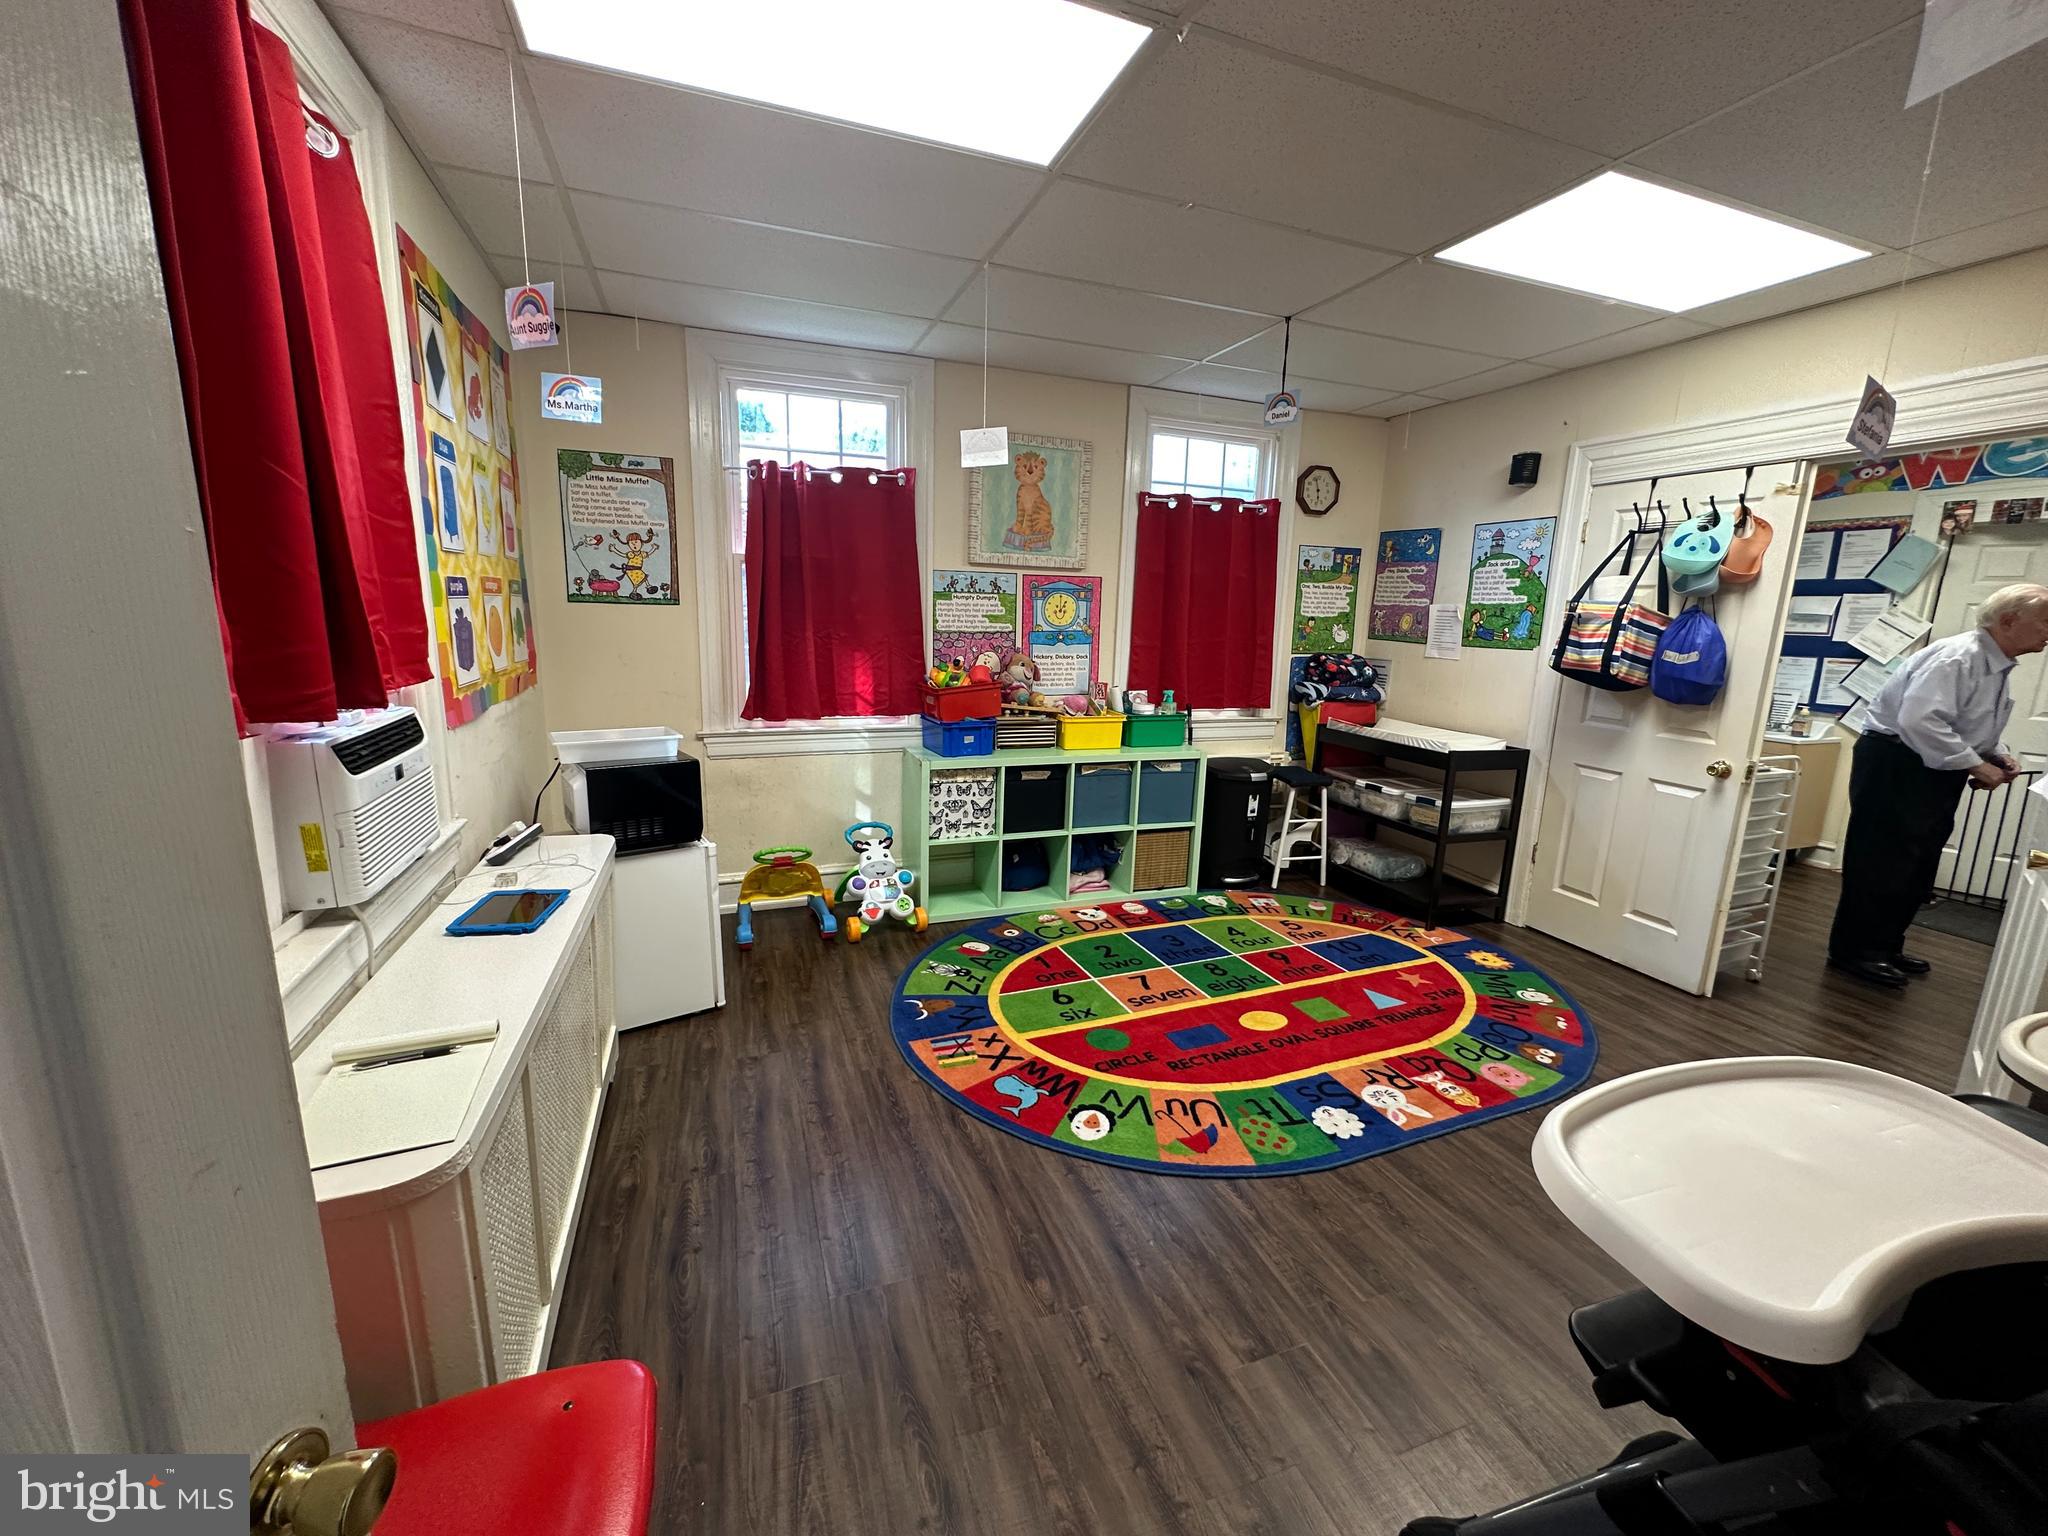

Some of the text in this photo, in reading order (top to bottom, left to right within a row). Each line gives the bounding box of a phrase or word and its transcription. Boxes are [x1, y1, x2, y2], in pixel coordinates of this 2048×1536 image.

[547, 399, 598, 413] Ms.Martha
[1271, 411, 1290, 420] Daniel
[625, 477, 649, 485] Muffet
[1034, 925, 1077, 940] Cc
[1226, 926, 1247, 939] 4
[1279, 920, 1304, 931] 5
[1161, 935, 1185, 948] 3
[1231, 934, 1275, 950] four
[1286, 927, 1328, 942] five
[1093, 945, 1121, 959] 2
[1159, 943, 1218, 961] three
[1326, 940, 1364, 955] 10
[968, 948, 1010, 972] Aa
[1034, 955, 1052, 970] 1
[1098, 955, 1144, 972] two
[1266, 950, 1292, 965] 9
[1349, 952, 1388, 967] ten
[1035, 969, 1080, 985] one
[1202, 962, 1229, 977] 8
[1279, 961, 1328, 979] nine
[1127, 973, 1151, 991] 7
[1206, 972, 1266, 993] eight
[1051, 989, 1075, 1006] 6
[1127, 987, 1197, 1009] seven
[1059, 1007, 1098, 1023] six
[1093, 986, 1462, 1073] CIRCLE RECTANGLE OVAL SQUARE TRIANGLE STAR
